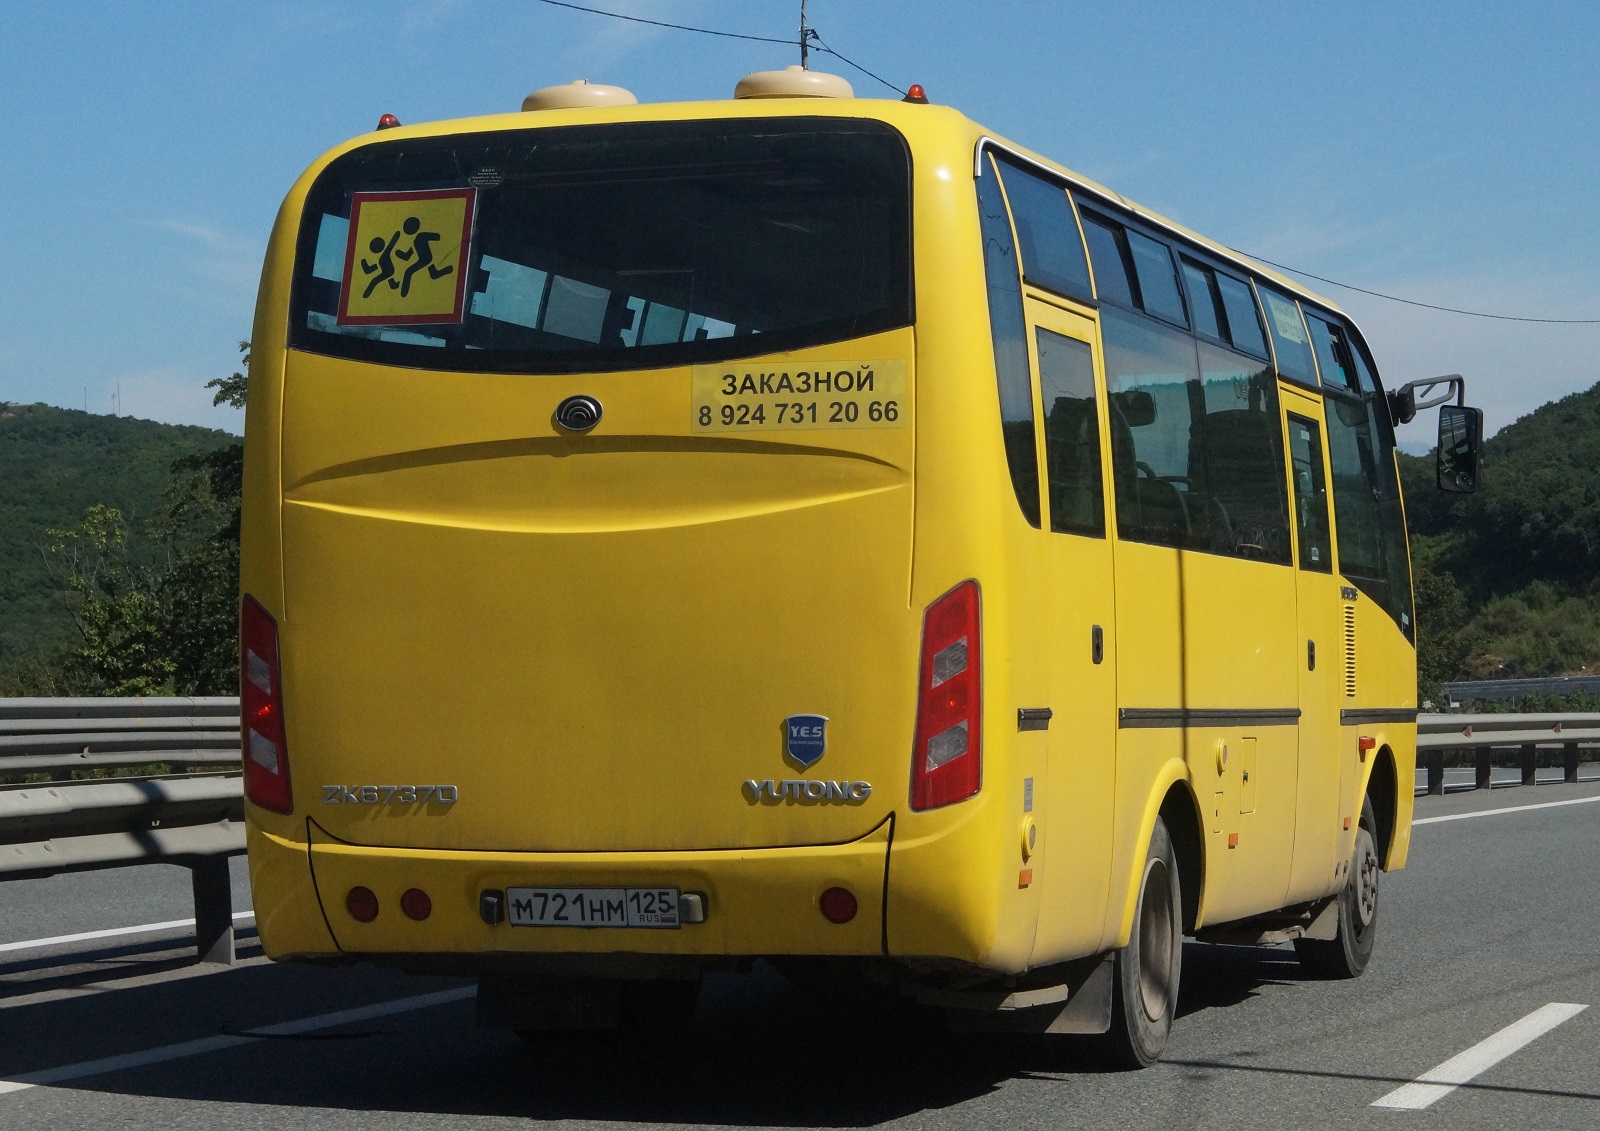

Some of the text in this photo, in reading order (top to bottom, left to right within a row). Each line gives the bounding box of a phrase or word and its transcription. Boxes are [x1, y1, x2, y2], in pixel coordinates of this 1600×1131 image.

[721, 365, 874, 395] ЗАКАЗНОЙ
[698, 400, 899, 426] 8 924 731 20 66
[322, 784, 458, 804] ZK6737D
[746, 779, 873, 800] YUTONG
[629, 891, 672, 914] 125
[639, 914, 660, 923] RUS
